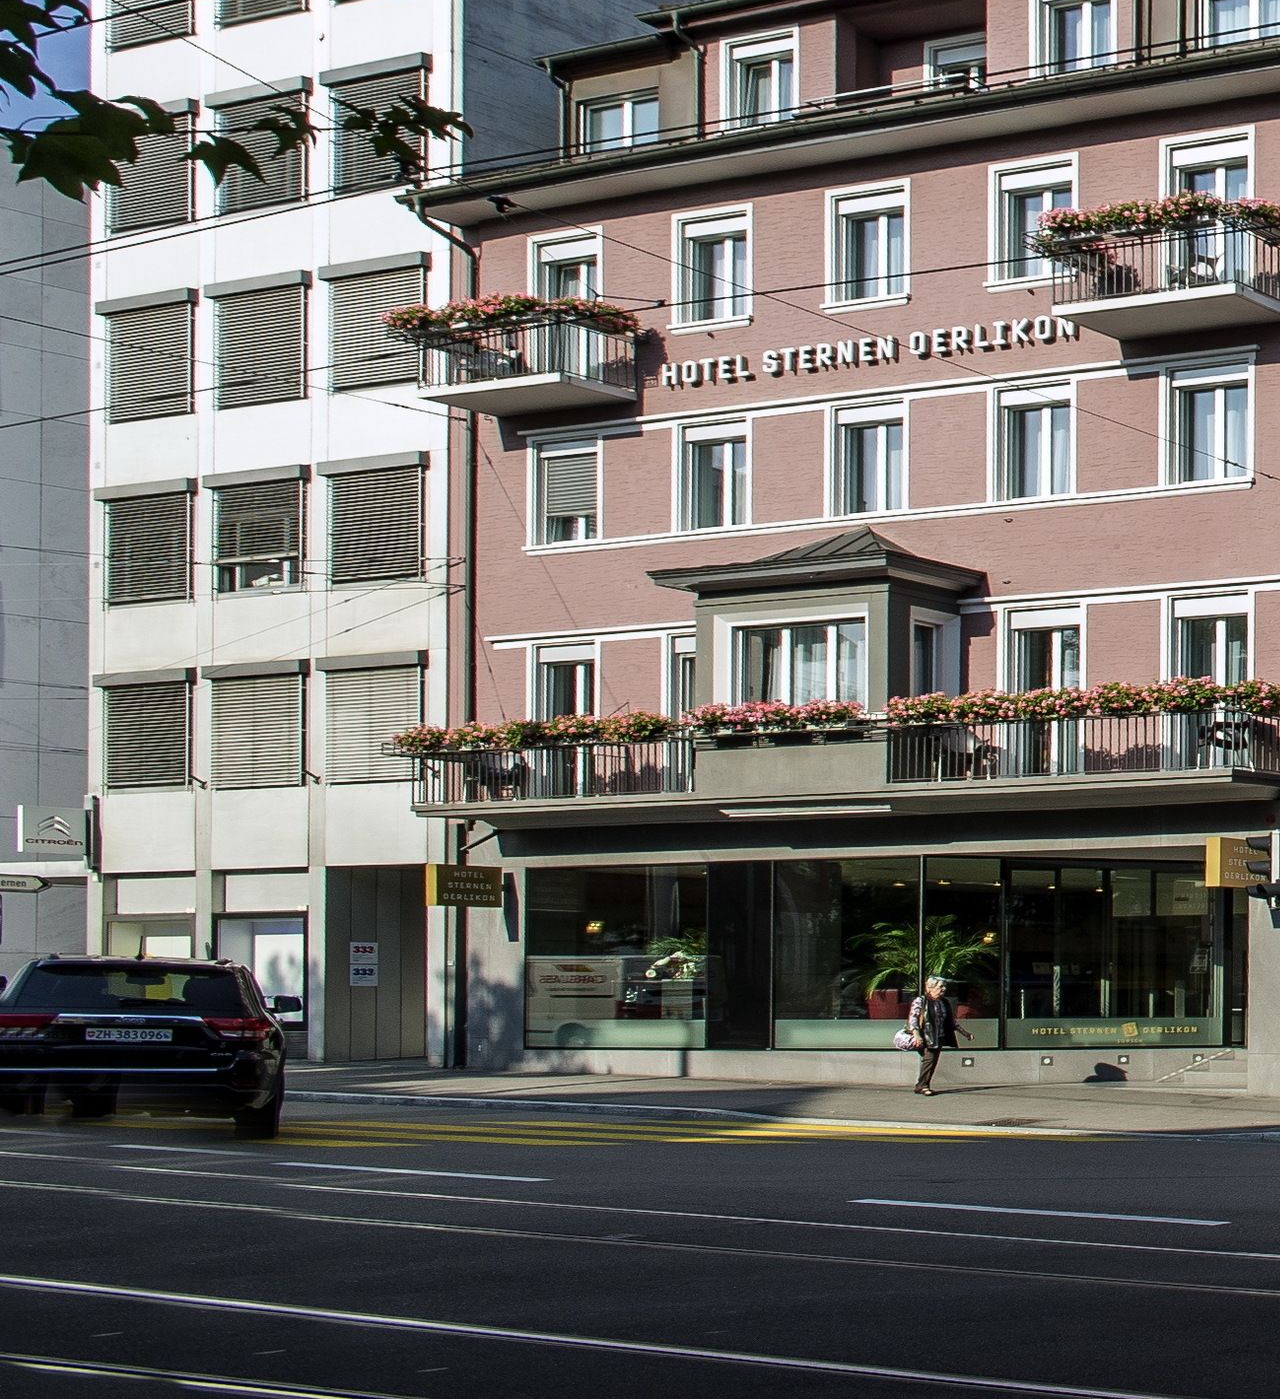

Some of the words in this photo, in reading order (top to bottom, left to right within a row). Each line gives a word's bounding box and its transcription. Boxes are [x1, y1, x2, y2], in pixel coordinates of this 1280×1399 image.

[662, 355, 750, 386] HOTEL
[762, 335, 896, 374] STERNEN
[909, 315, 1077, 355] OERLIKON
[25, 838, 83, 846] CITROËN
[454, 871, 485, 879] HOTEL
[1224, 872, 1267, 881] OERLIKON
[0, 879, 27, 888] ernen
[447, 882, 492, 890] STERNEN
[443, 892, 496, 901] OERLIKON
[95, 1029, 111, 1040] ZH
[1031, 1027, 1066, 1035] HOTEL
[1070, 1027, 1117, 1035] STERNEN
[1142, 1026, 1198, 1035] OERLIKON
